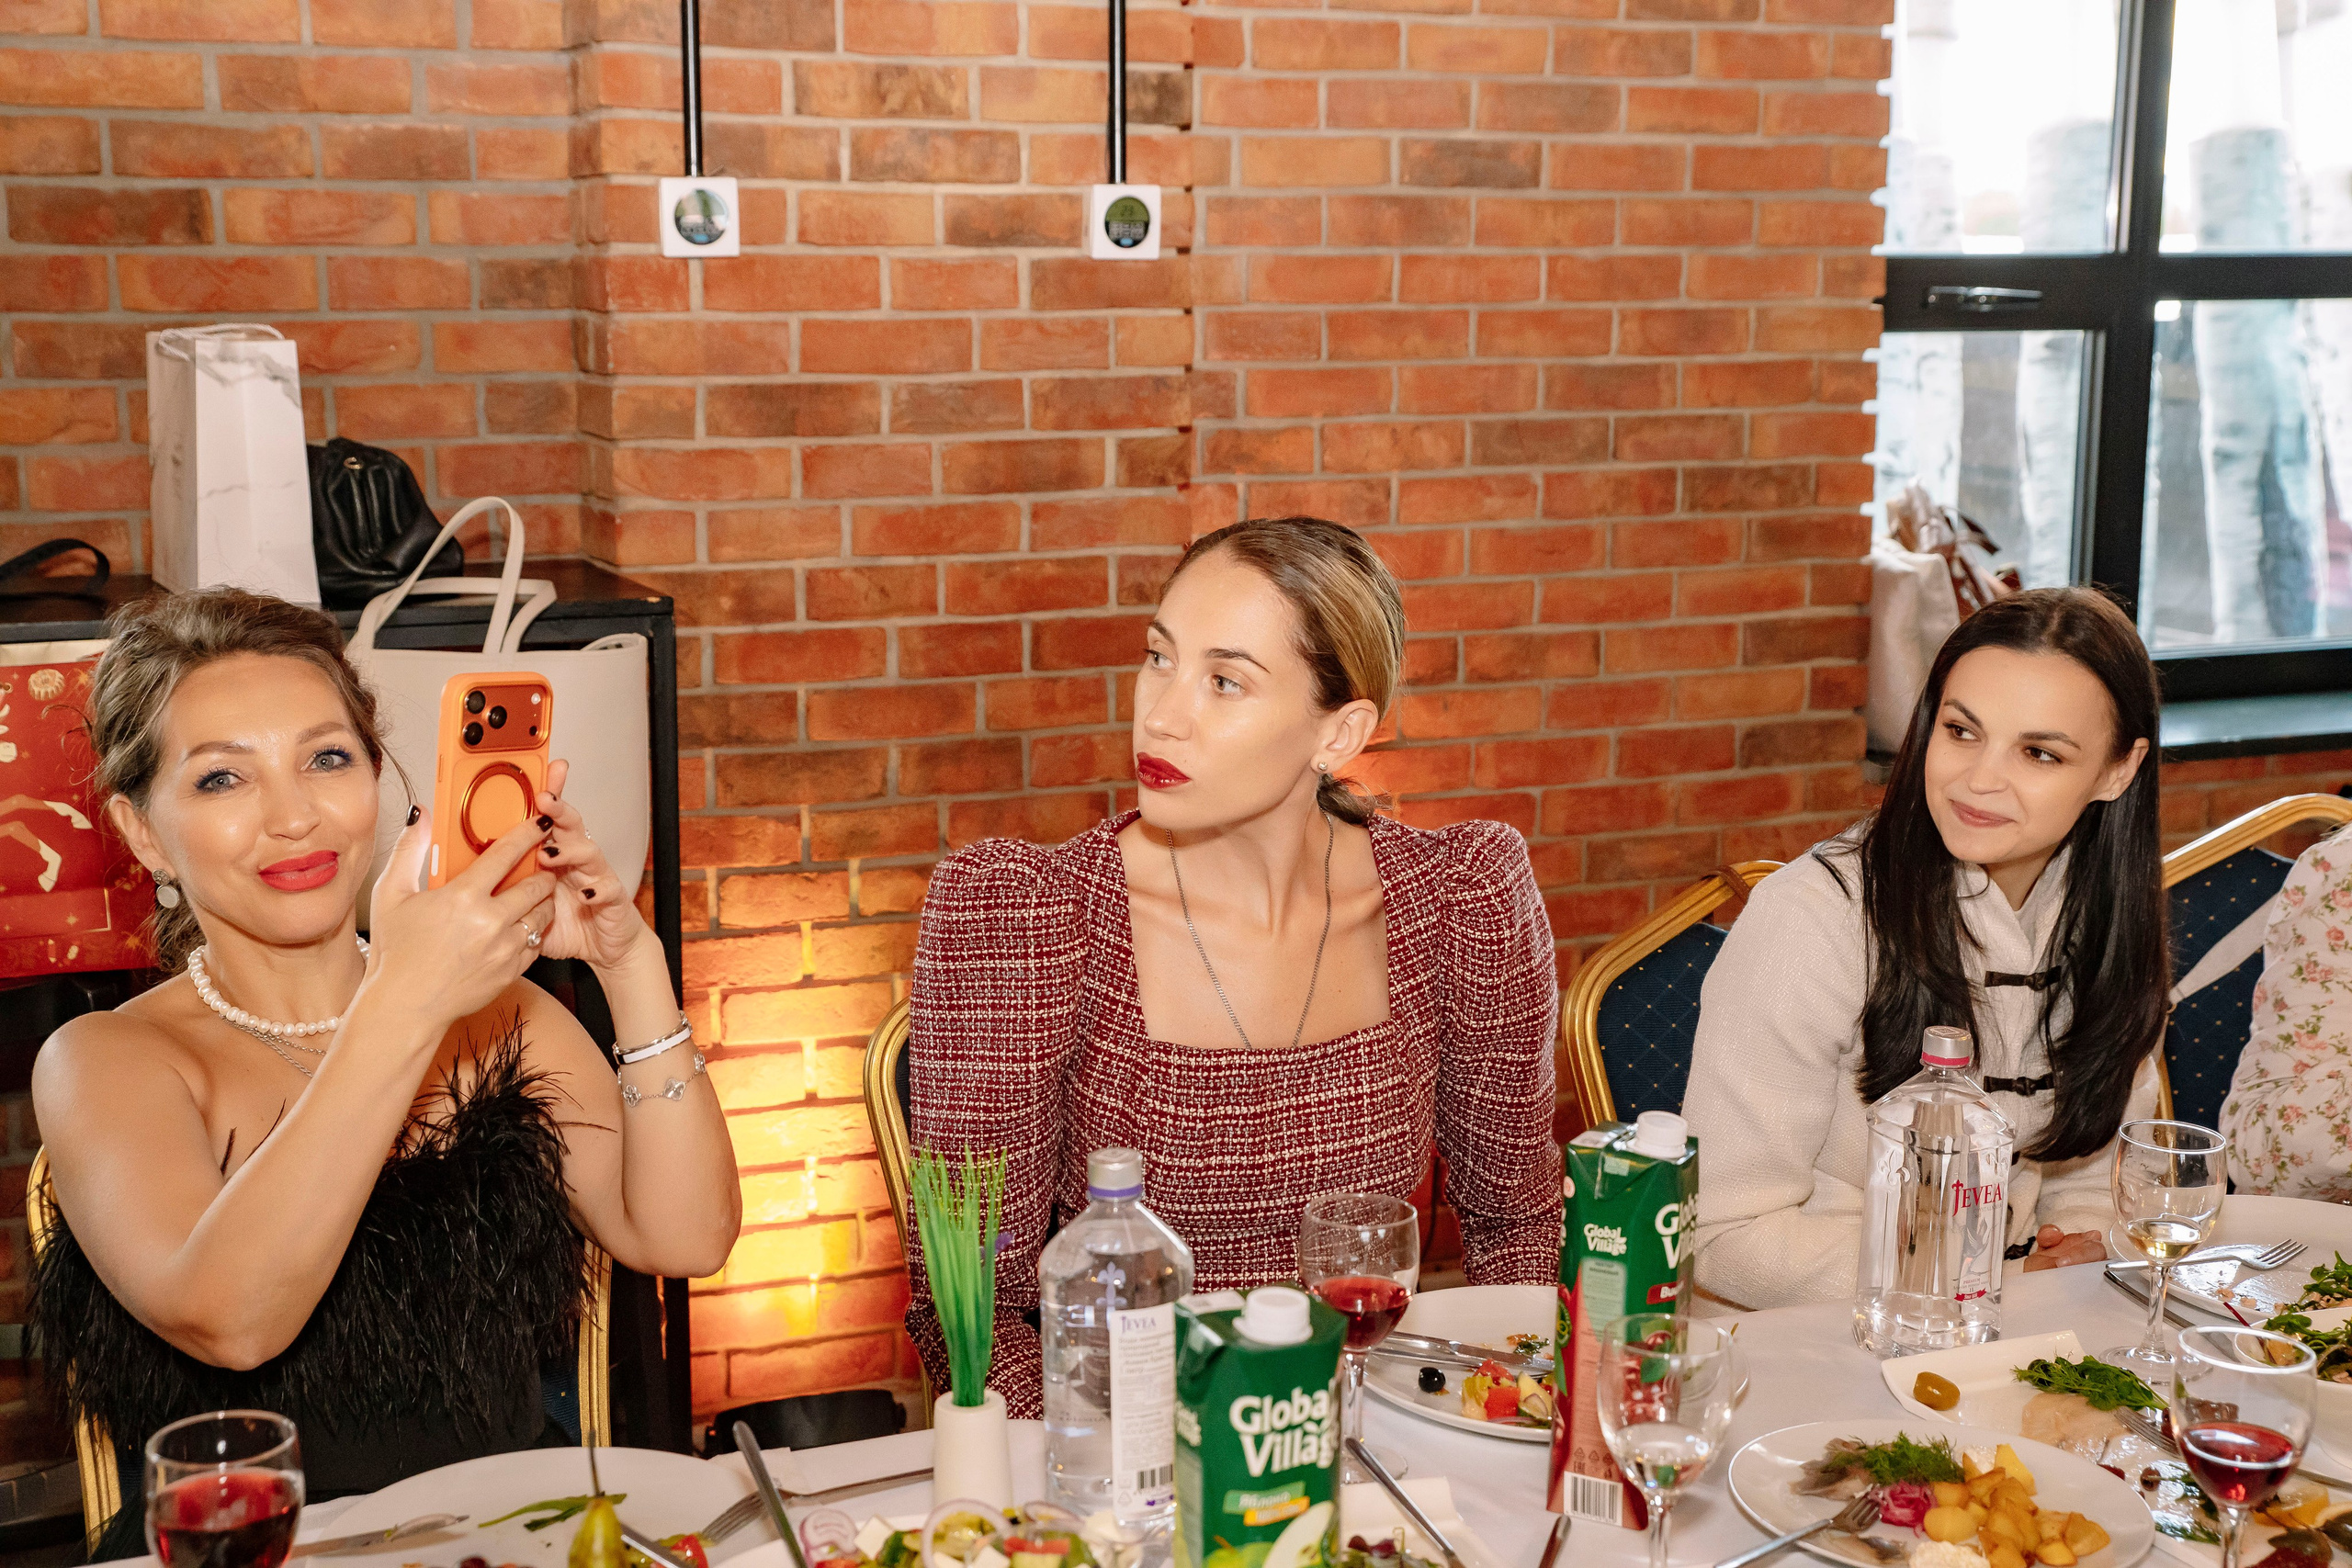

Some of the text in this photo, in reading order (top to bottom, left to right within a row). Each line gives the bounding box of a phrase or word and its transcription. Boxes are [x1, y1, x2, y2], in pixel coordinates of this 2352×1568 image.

[1951, 1179, 2002, 1217] JEVEA
[1583, 1223, 1623, 1240] Global
[1587, 1236, 1628, 1257] Village
[1120, 1314, 1157, 1335] JEVEA
